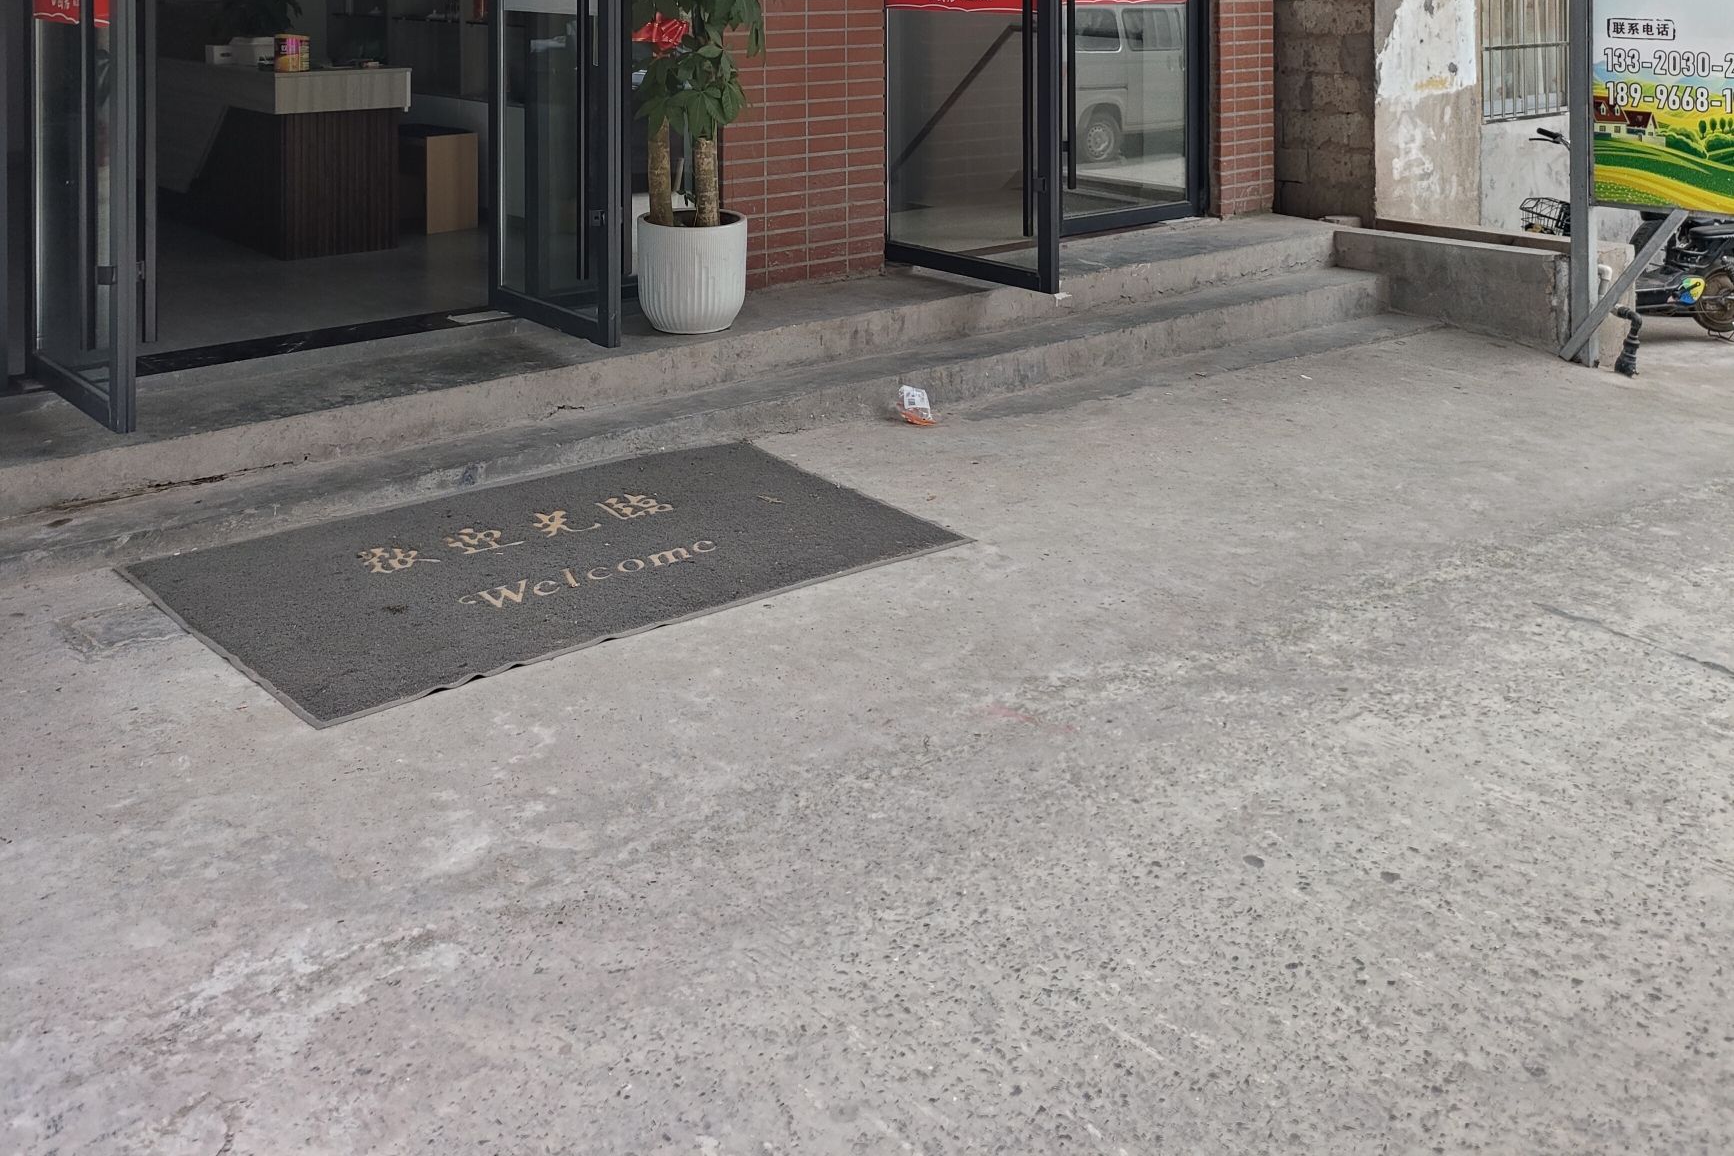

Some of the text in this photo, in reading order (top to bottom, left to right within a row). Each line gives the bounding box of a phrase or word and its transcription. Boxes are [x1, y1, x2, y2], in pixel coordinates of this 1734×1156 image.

[1612, 22, 1670, 37] 联系电话
[1605, 81, 1734, 114] 189-9668-1
[458, 540, 718, 608] Welcome
